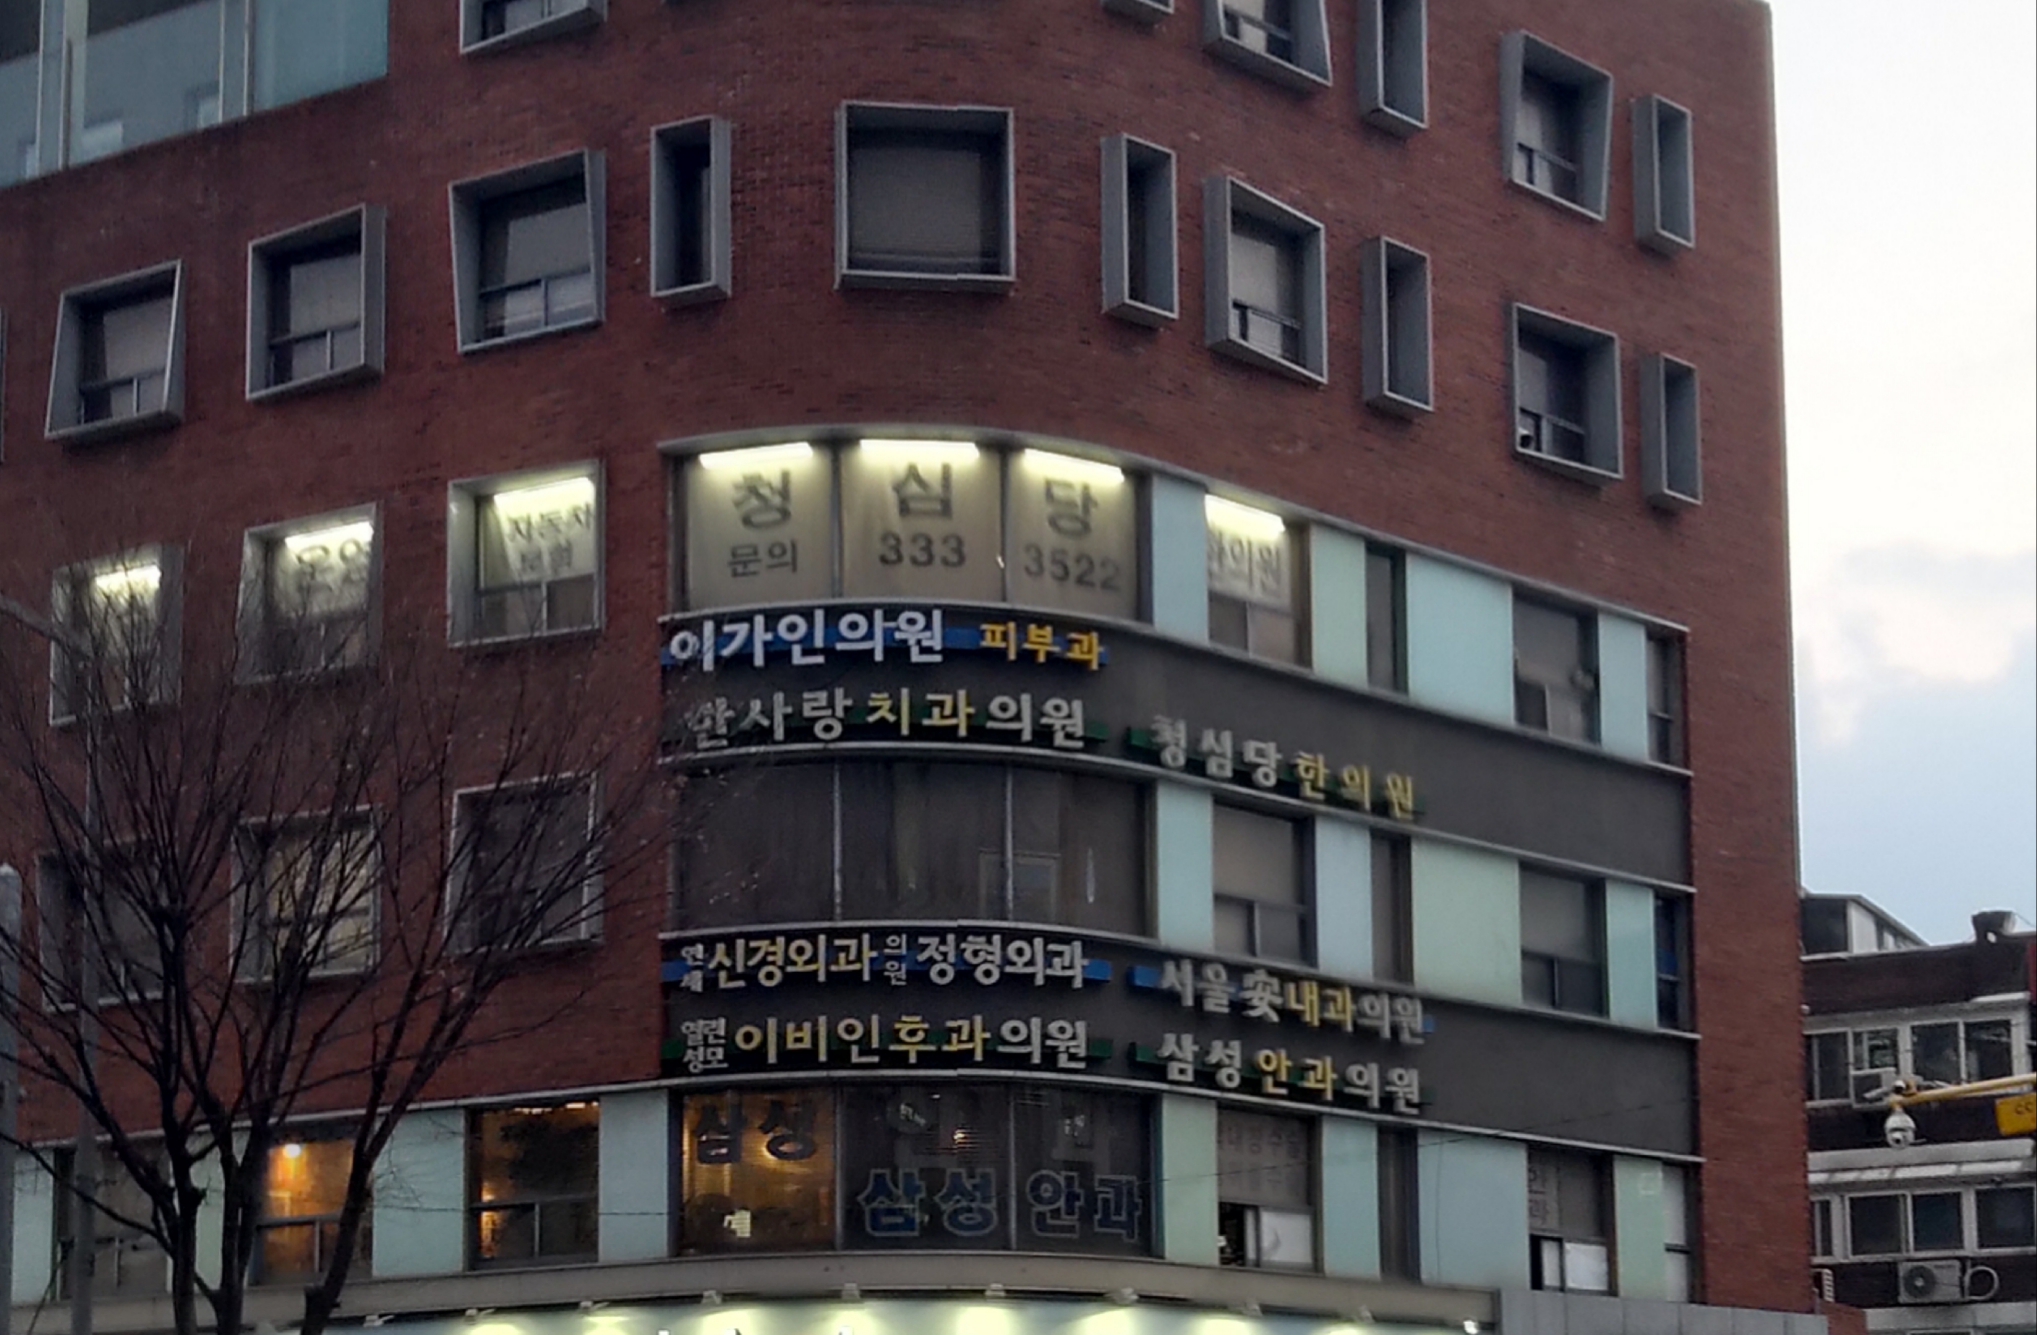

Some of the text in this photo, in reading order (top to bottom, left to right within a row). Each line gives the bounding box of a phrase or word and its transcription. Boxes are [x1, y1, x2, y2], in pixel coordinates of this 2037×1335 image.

[727, 541, 798, 577] 문의
[879, 533, 1121, 592] 333 3522
[670, 609, 1104, 671] 이가인의원 피부과
[685, 687, 1086, 749] 한사랑치과의원
[709, 933, 878, 988] 신경외과
[917, 933, 1088, 988] 정형외과
[735, 1014, 1087, 1069] 이비인후과의원
[1157, 1033, 1420, 1115] 삼성안과의원
[857, 1168, 1143, 1243] 삼성 안과
